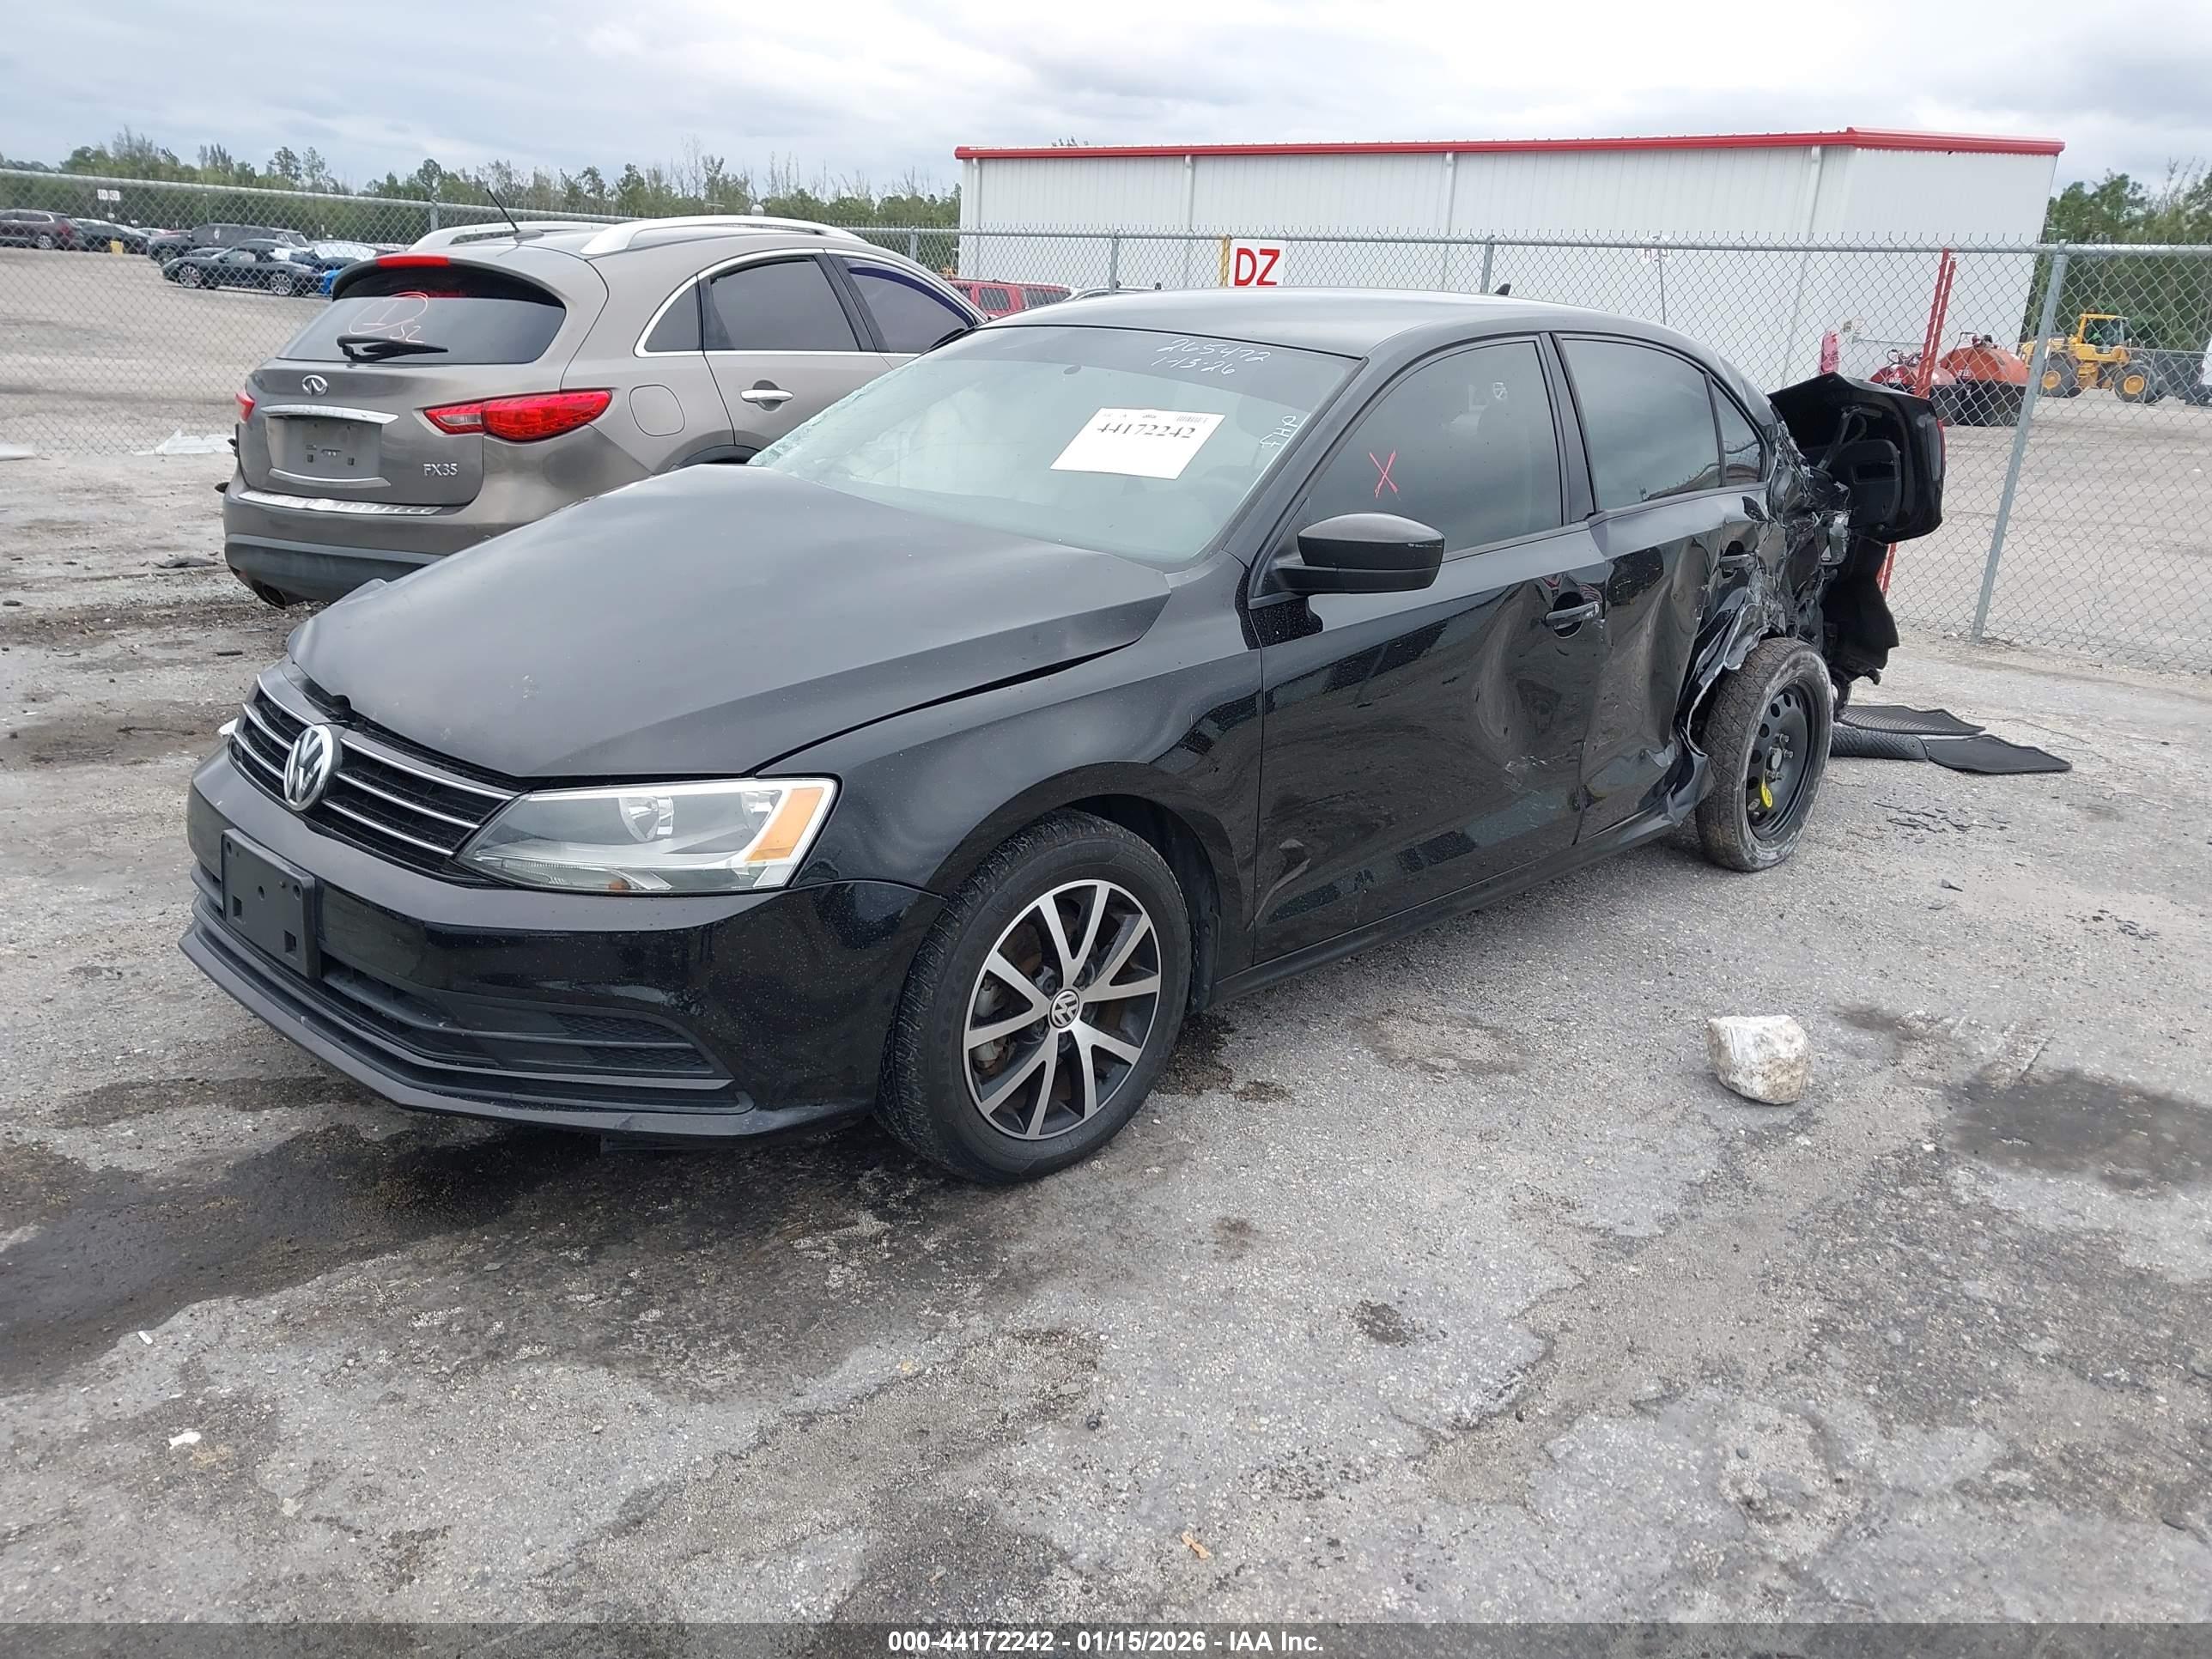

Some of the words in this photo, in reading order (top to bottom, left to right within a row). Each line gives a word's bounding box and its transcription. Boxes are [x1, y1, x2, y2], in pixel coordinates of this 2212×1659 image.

[1235, 248, 1280, 286] DZ
[1097, 422, 1196, 439] 44172242
[423, 463, 458, 476] FX35
